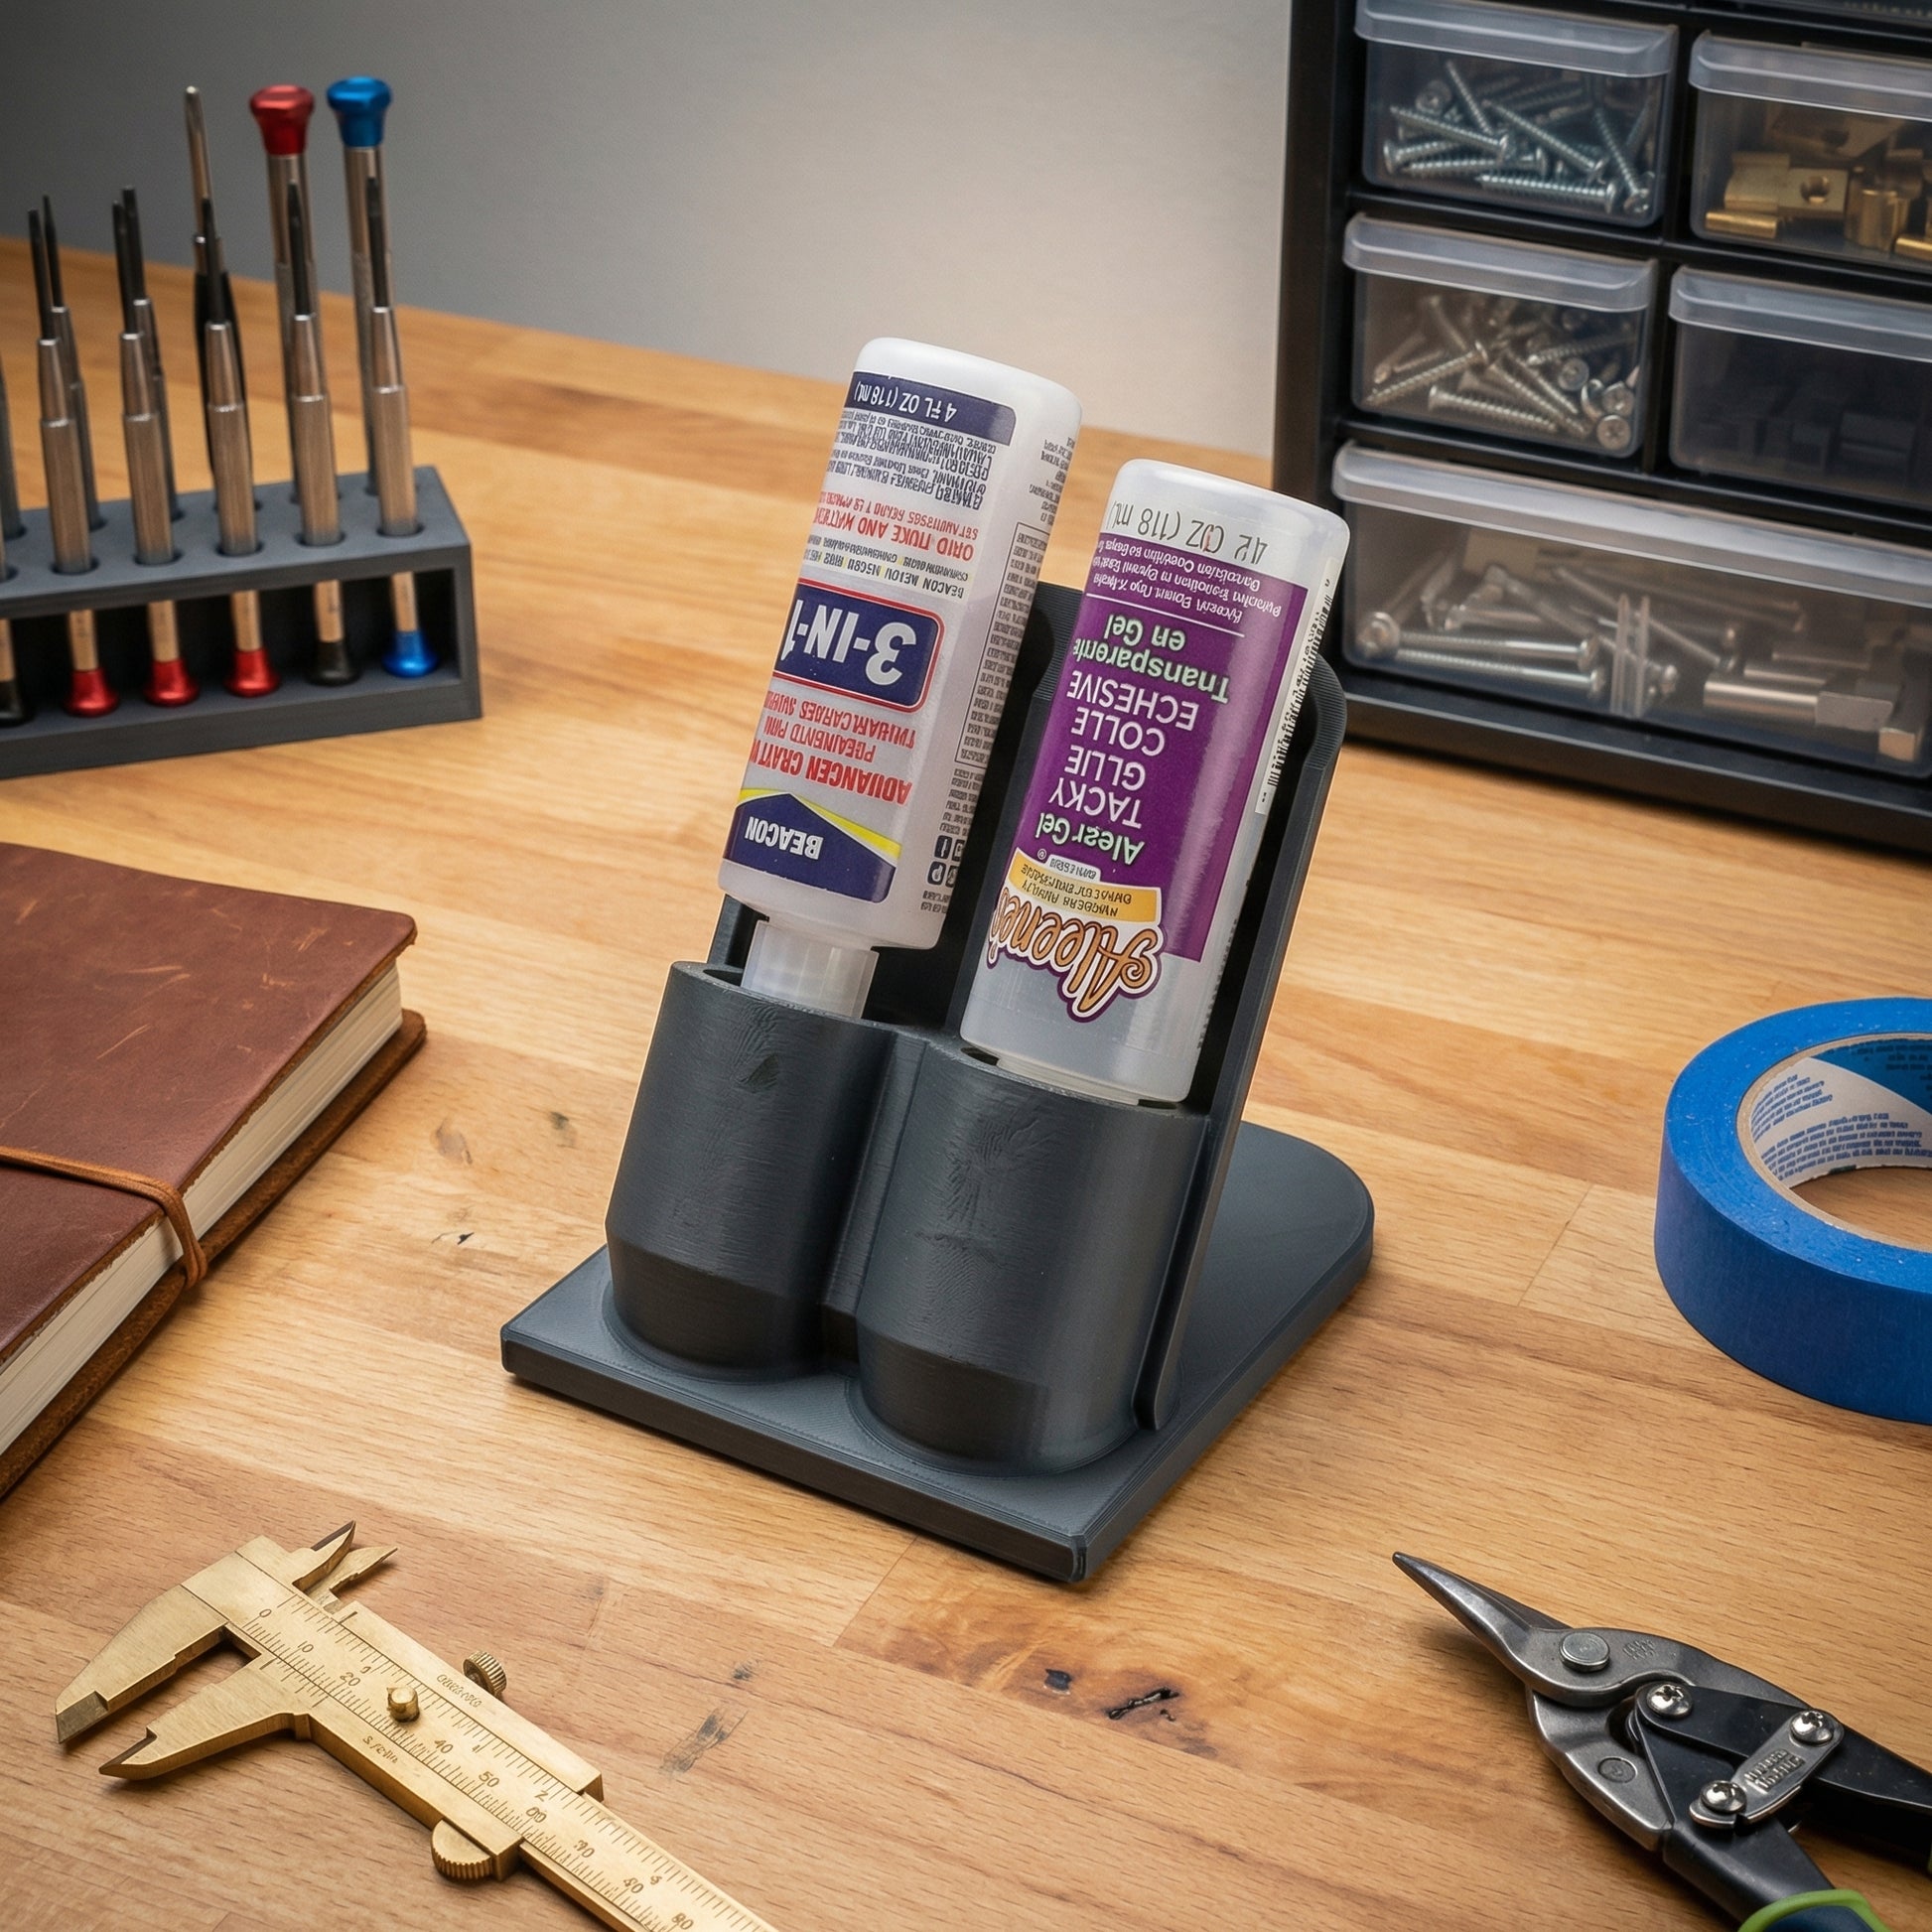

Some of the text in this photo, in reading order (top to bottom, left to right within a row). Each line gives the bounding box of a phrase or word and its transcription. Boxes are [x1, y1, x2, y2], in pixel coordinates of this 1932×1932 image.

[898, 391, 919, 412] OZ
[943, 401, 957, 420] 4
[1137, 507, 1181, 541] (118
[1103, 613, 1185, 648] en Gel
[1065, 669, 1199, 731] ECHESIVE
[1069, 705, 1167, 758] COLLE
[1047, 776, 1143, 828] TACKY
[744, 815, 823, 860] BEACON
[1035, 811, 1071, 846] Gel
[298, 1640, 315, 1653] 10
[479, 1771, 500, 1788] 50
